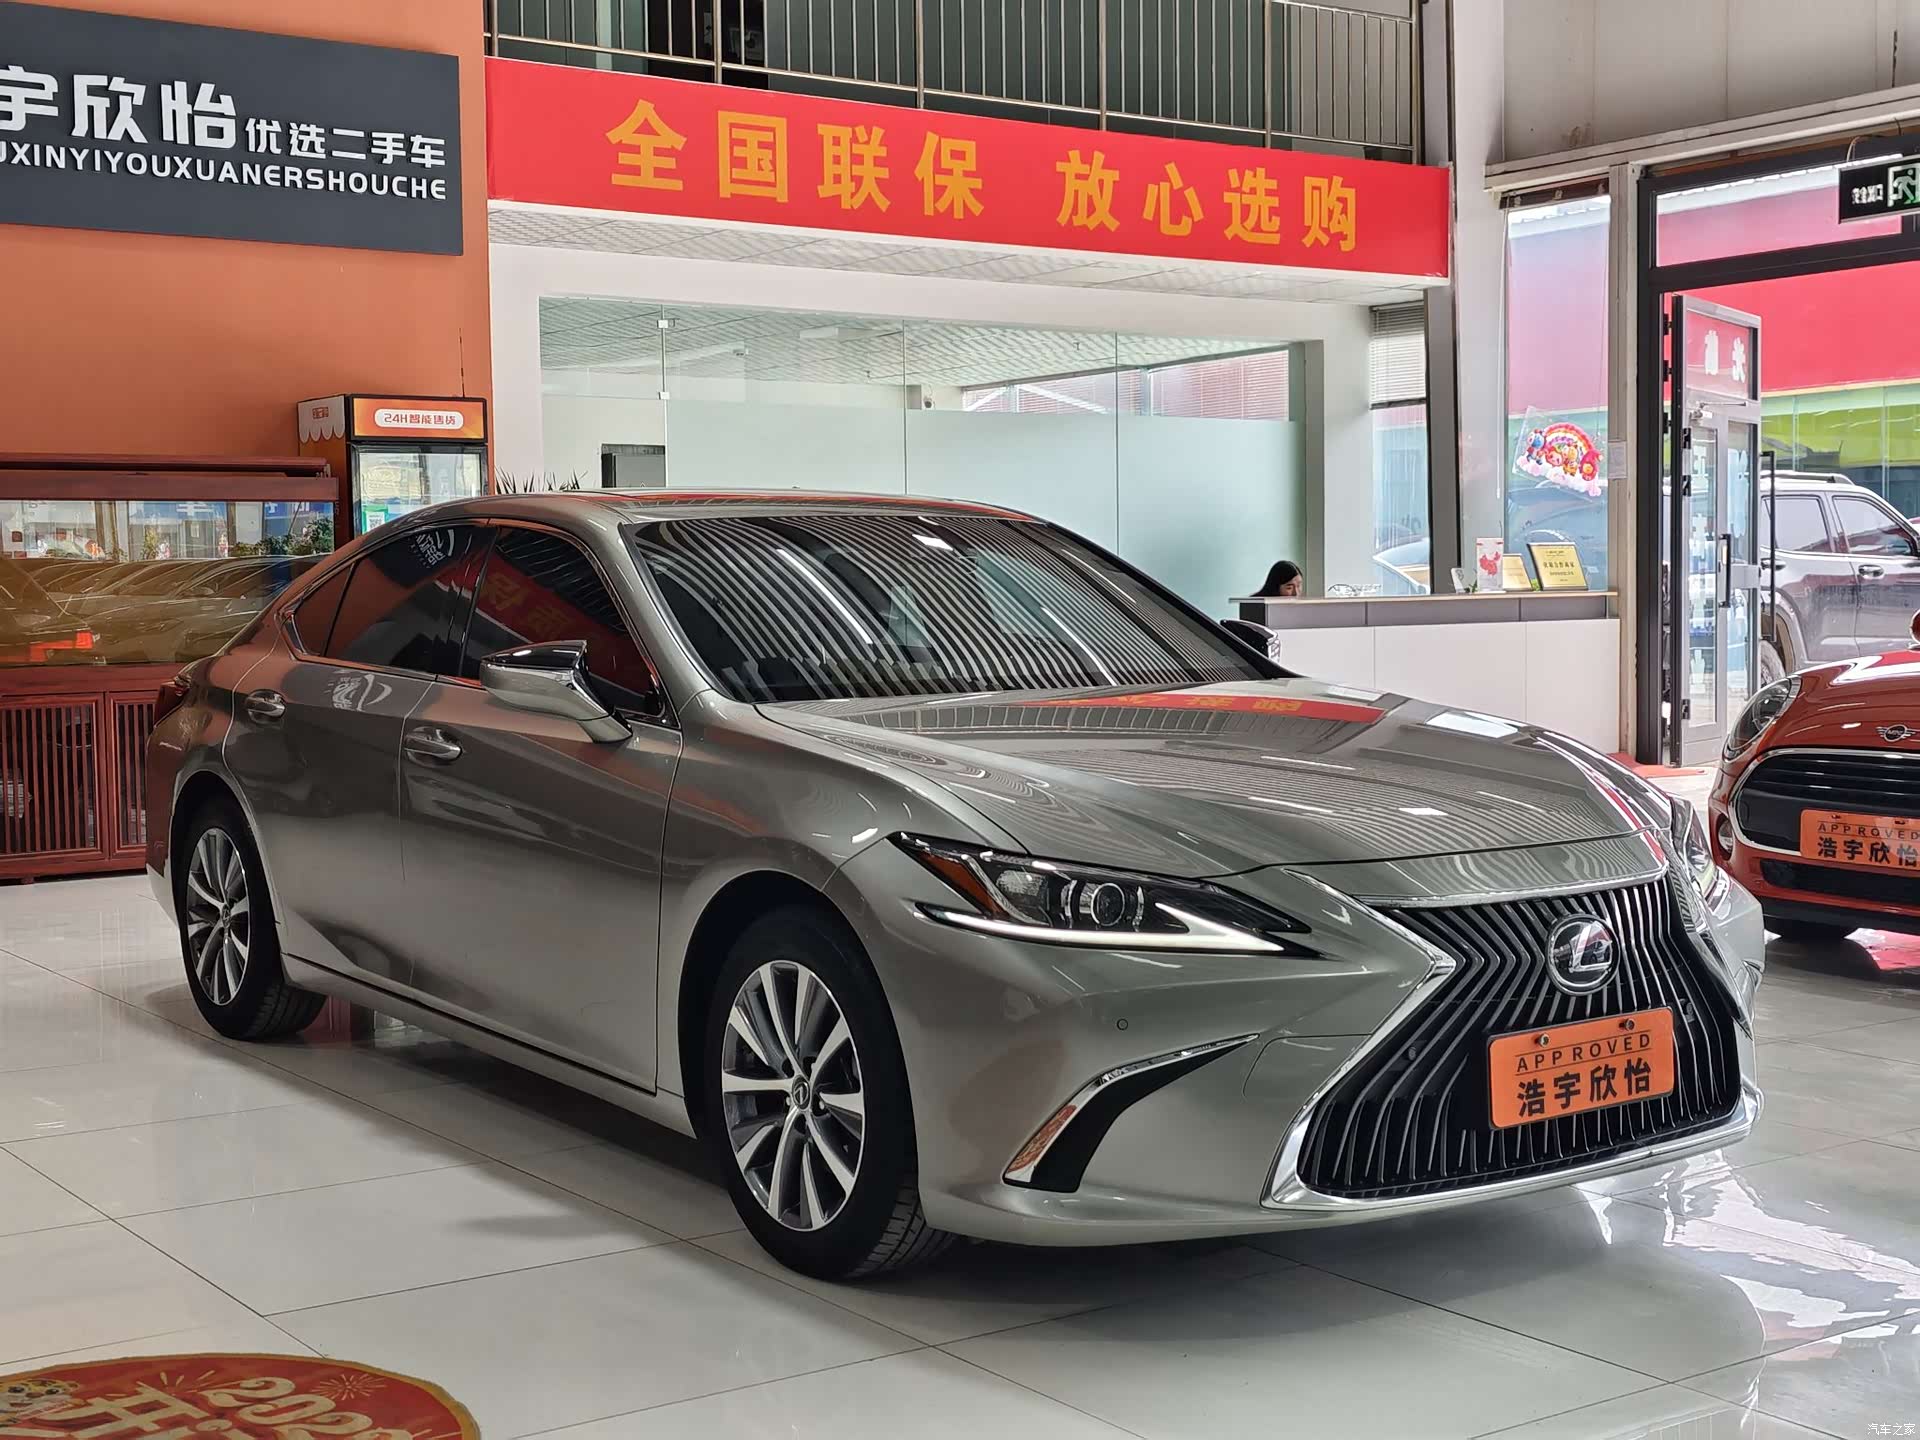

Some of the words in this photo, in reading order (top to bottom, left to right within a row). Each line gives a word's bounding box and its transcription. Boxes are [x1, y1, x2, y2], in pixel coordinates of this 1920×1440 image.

[245, 117, 446, 168] 优选二手车
[606, 99, 985, 219] 全国联保
[1055, 149, 1357, 251] 放心选购
[383, 412, 456, 426] 24H智能售货
[1817, 821, 1920, 841] APPROVED
[1816, 836, 1918, 867] 浩宇欣怡
[1516, 1033, 1651, 1073] APPROVED
[1516, 1056, 1652, 1119] 浩宇欣怡
